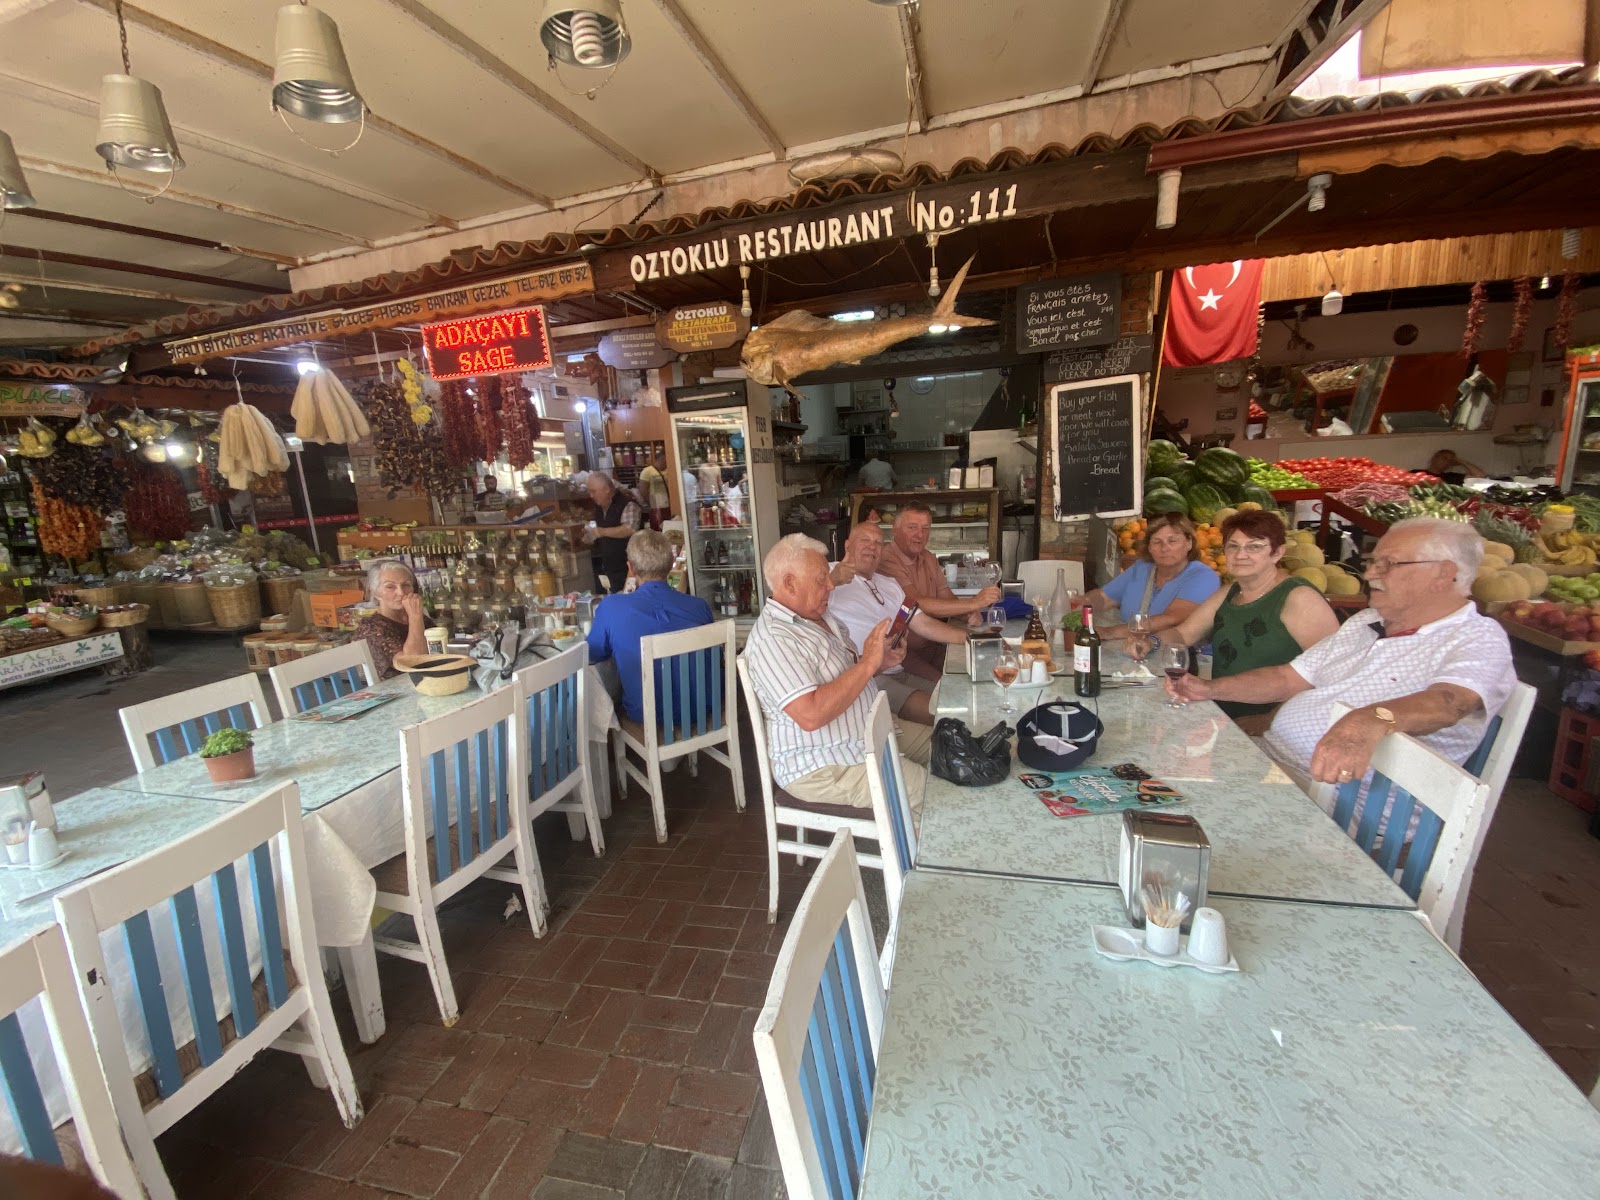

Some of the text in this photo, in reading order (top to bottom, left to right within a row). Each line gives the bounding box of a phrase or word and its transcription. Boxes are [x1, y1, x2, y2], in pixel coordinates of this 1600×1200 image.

[630, 239, 729, 282] OZTOKLU
[738, 206, 893, 262] RESTAURANT
[427, 289, 469, 311] BAYRAM
[675, 305, 727, 321] ÖZTOKLU
[672, 315, 732, 329] RESTAURANT
[1070, 321, 1079, 330] et
[434, 313, 531, 349] ADAÇAYI
[1029, 336, 1048, 347] Bon
[457, 345, 516, 373] SAGE
[1058, 366, 1127, 380] PLEASE DO TRY
[1060, 360, 1093, 373] COOKED
[1059, 390, 1118, 412] Buy your Fish
[1095, 407, 1116, 417] next
[1083, 429, 1099, 440] you
[1090, 462, 1120, 475] Bread
